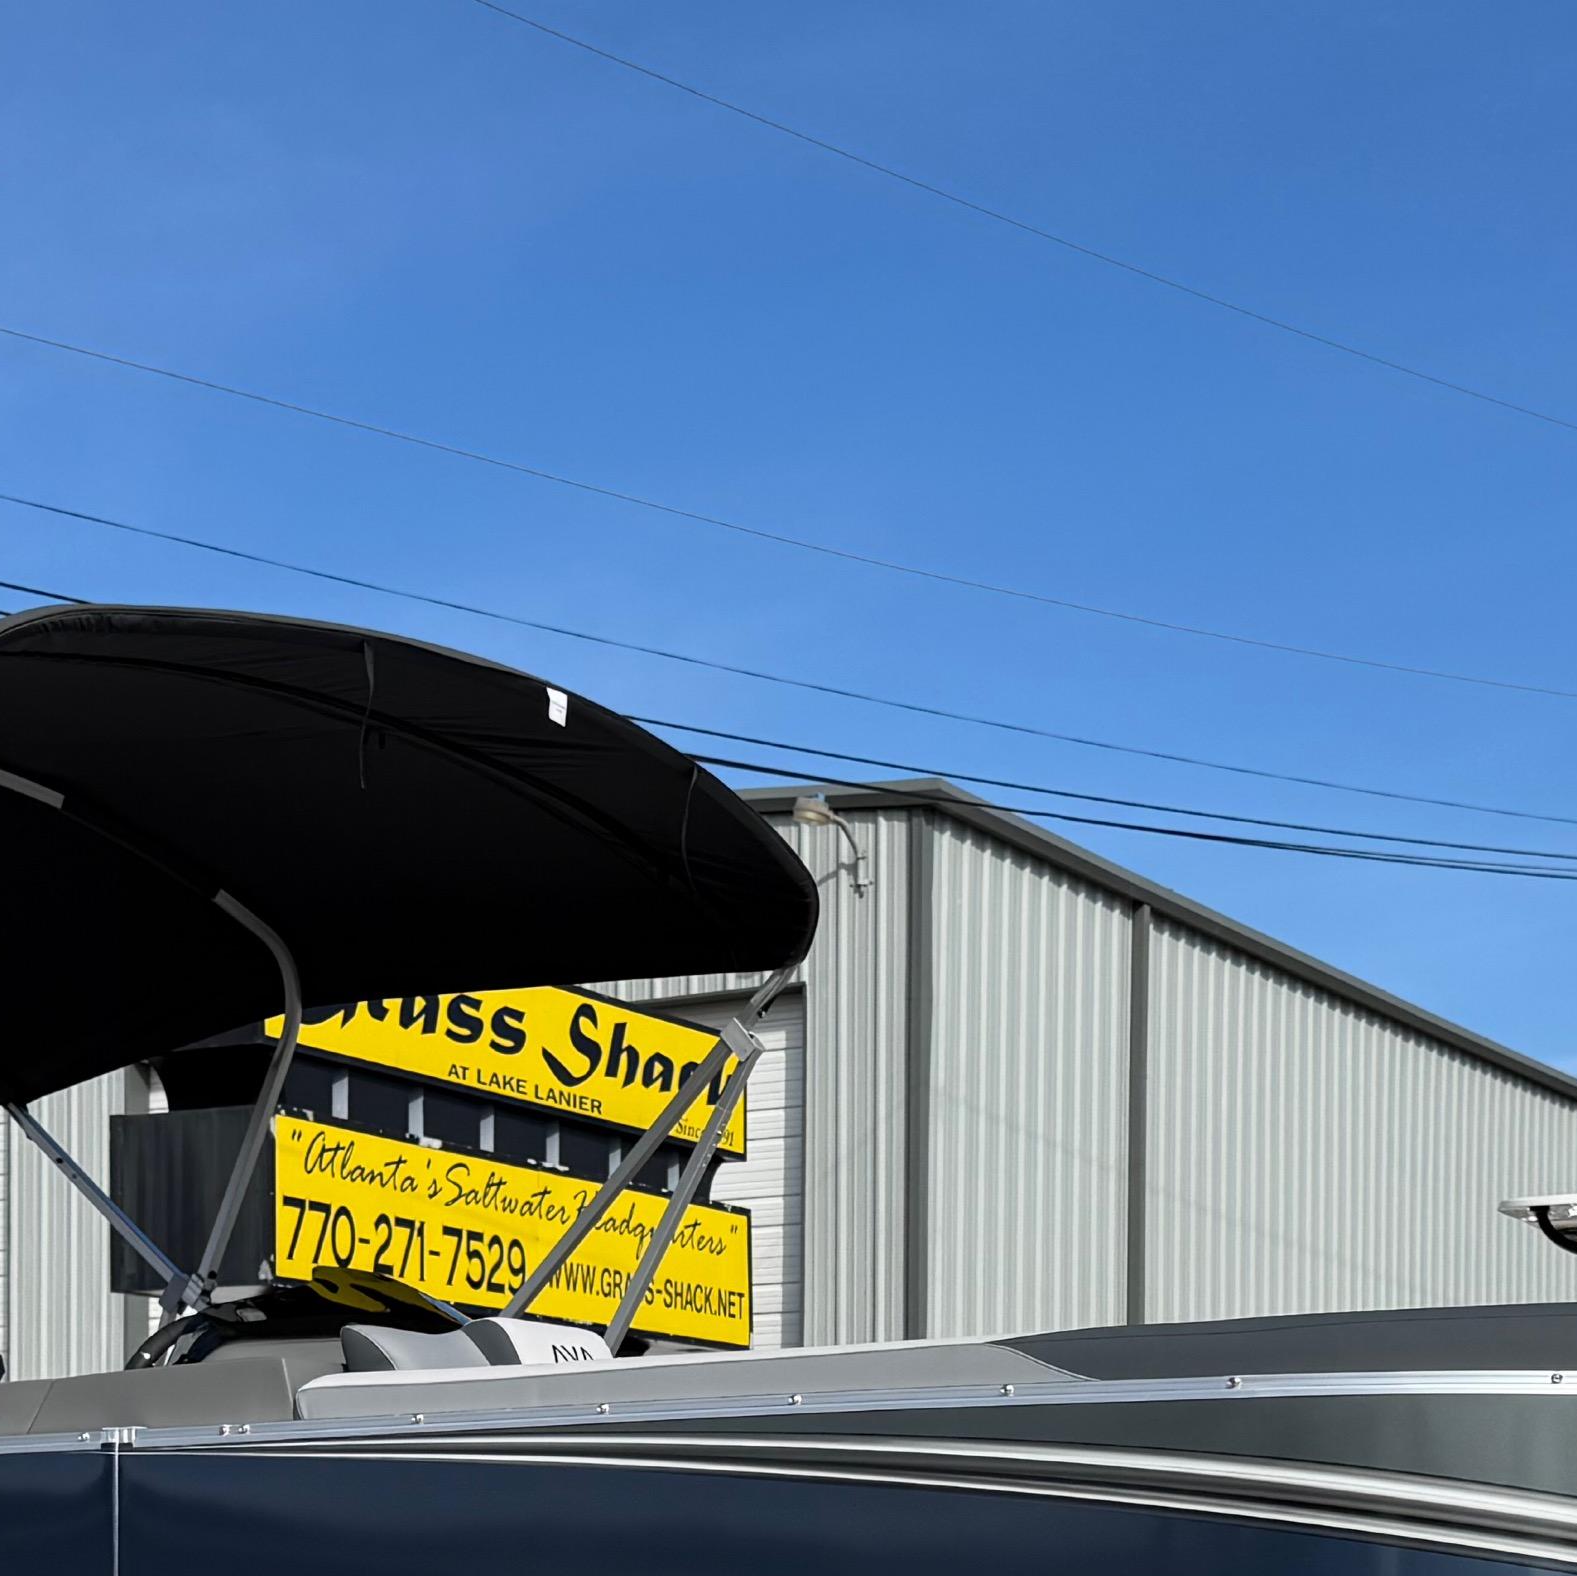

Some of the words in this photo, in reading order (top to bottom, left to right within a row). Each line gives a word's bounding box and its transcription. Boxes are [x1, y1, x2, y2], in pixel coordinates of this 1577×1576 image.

[298, 993, 526, 1055] ass
[448, 1063, 469, 1081] AT
[477, 1068, 527, 1096] LAKE
[535, 1084, 602, 1115] LANIER
[675, 1118, 703, 1139] Sinc
[445, 1162, 571, 1224] Saltwater
[282, 1194, 526, 1295] 770-271-7529
